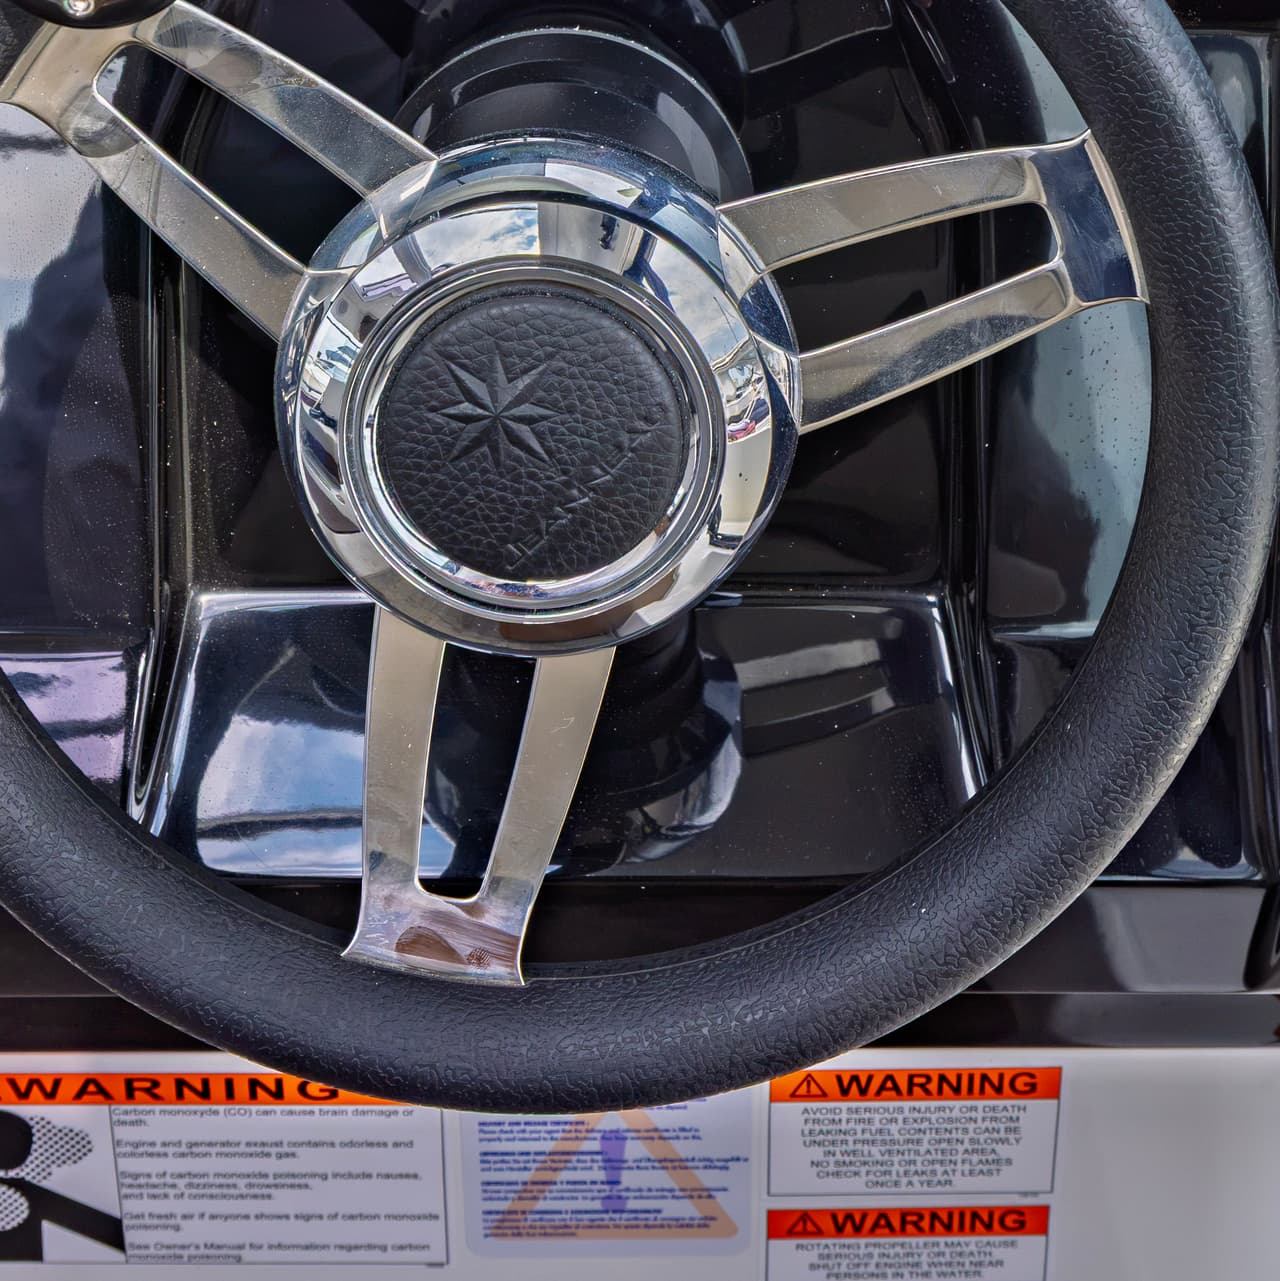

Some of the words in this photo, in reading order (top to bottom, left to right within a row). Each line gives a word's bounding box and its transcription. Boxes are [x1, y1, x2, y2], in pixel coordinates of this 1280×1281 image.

[7, 1076, 340, 1102] WARNING
[835, 1072, 1039, 1098] WARNING
[112, 1108, 156, 1117] Carbon
[158, 1108, 220, 1118] monoxyde
[255, 1109, 276, 1117] can
[280, 1109, 316, 1117] cause
[318, 1107, 348, 1117] brain
[352, 1107, 400, 1118] damage
[800, 1107, 842, 1116] AVOID
[846, 1106, 904, 1115] SERIOUS
[908, 1105, 956, 1115] INJURY
[958, 1105, 978, 1114] OR
[982, 1104, 1028, 1114] DEATH
[112, 1118, 150, 1128] death.
[804, 1118, 842, 1127] FROM
[846, 1117, 876, 1126] FIRE
[880, 1117, 898, 1126] OR
[902, 1116, 978, 1125] EXPLOSION
[982, 1115, 1020, 1124] FROM
[800, 1128, 858, 1138] LEAKING
[861, 1128, 895, 1137] FUEL
[897, 1127, 970, 1136] CONTENTS
[972, 1126, 1000, 1135] CAN
[1004, 1126, 1022, 1135] BE
[116, 1140, 156, 1150] Engine
[160, 1140, 182, 1149] and
[186, 1140, 240, 1150] generator
[244, 1140, 284, 1148] exaust
[287, 1140, 336, 1148] contains
[339, 1140, 388, 1148] odorless
[392, 1140, 414, 1149] and
[802, 1139, 849, 1148] UNDER
[852, 1138, 924, 1147] PRESSURE
[927, 1138, 964, 1147] OPEN
[968, 1137, 1022, 1146] SLOWLY
[116, 1150, 168, 1159] colorless
[172, 1150, 212, 1159] carbon
[216, 1150, 272, 1159] monoxide
[823, 1149, 836, 1158] IN
[840, 1149, 874, 1158] WELL
[878, 1148, 959, 1157] VENTILATED
[810, 1160, 830, 1168] NO
[833, 1160, 894, 1168] SMOKING
[898, 1160, 916, 1168] OR
[920, 1159, 958, 1167] OPEN
[960, 1158, 1013, 1167] FLAMES
[120, 1171, 152, 1181] Signs
[156, 1171, 167, 1181] of
[170, 1171, 210, 1181] carbon
[213, 1171, 270, 1181] monoxide
[272, 1171, 328, 1181] poisoning
[331, 1171, 372, 1181] include
[816, 1170, 860, 1179] CHECK
[864, 1170, 892, 1178] FOR
[896, 1169, 938, 1178] LEAKS
[942, 1169, 957, 1177] AT
[960, 1168, 1002, 1177] LEAST
[864, 1180, 902, 1189] ONCE
[904, 1180, 914, 1188] A
[831, 1209, 1027, 1233] WARNING
[795, 1243, 861, 1252] ROTATING
[864, 1241, 940, 1250] PROPELLER
[944, 1241, 972, 1249] MAY
[975, 1240, 1018, 1249] CAUSE
